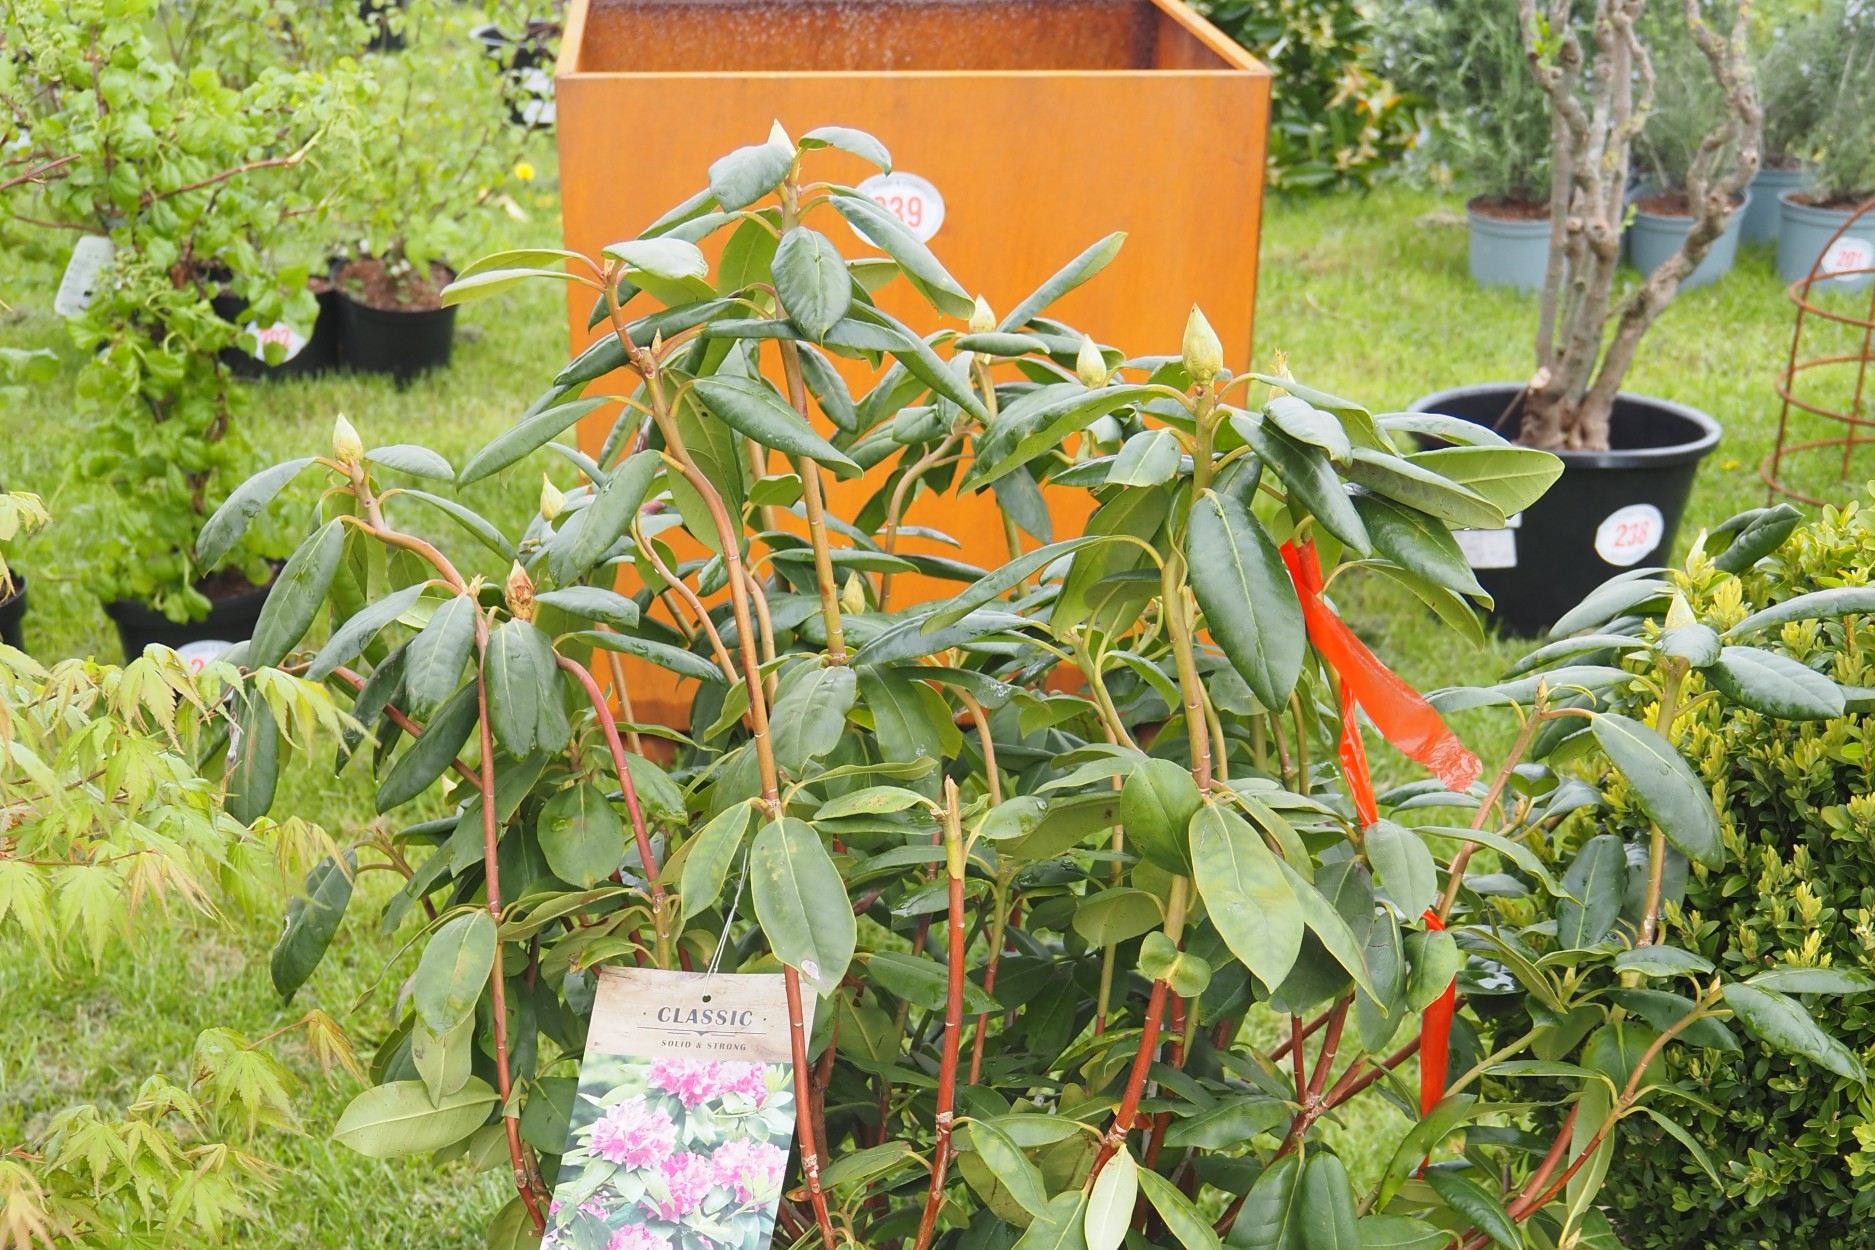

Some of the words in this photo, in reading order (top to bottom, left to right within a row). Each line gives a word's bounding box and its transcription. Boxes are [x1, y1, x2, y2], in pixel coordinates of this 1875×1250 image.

[657, 1006, 753, 1027] CLASSIC
[661, 1040, 691, 1049] SOLID
[707, 1042, 746, 1051] STRONG
